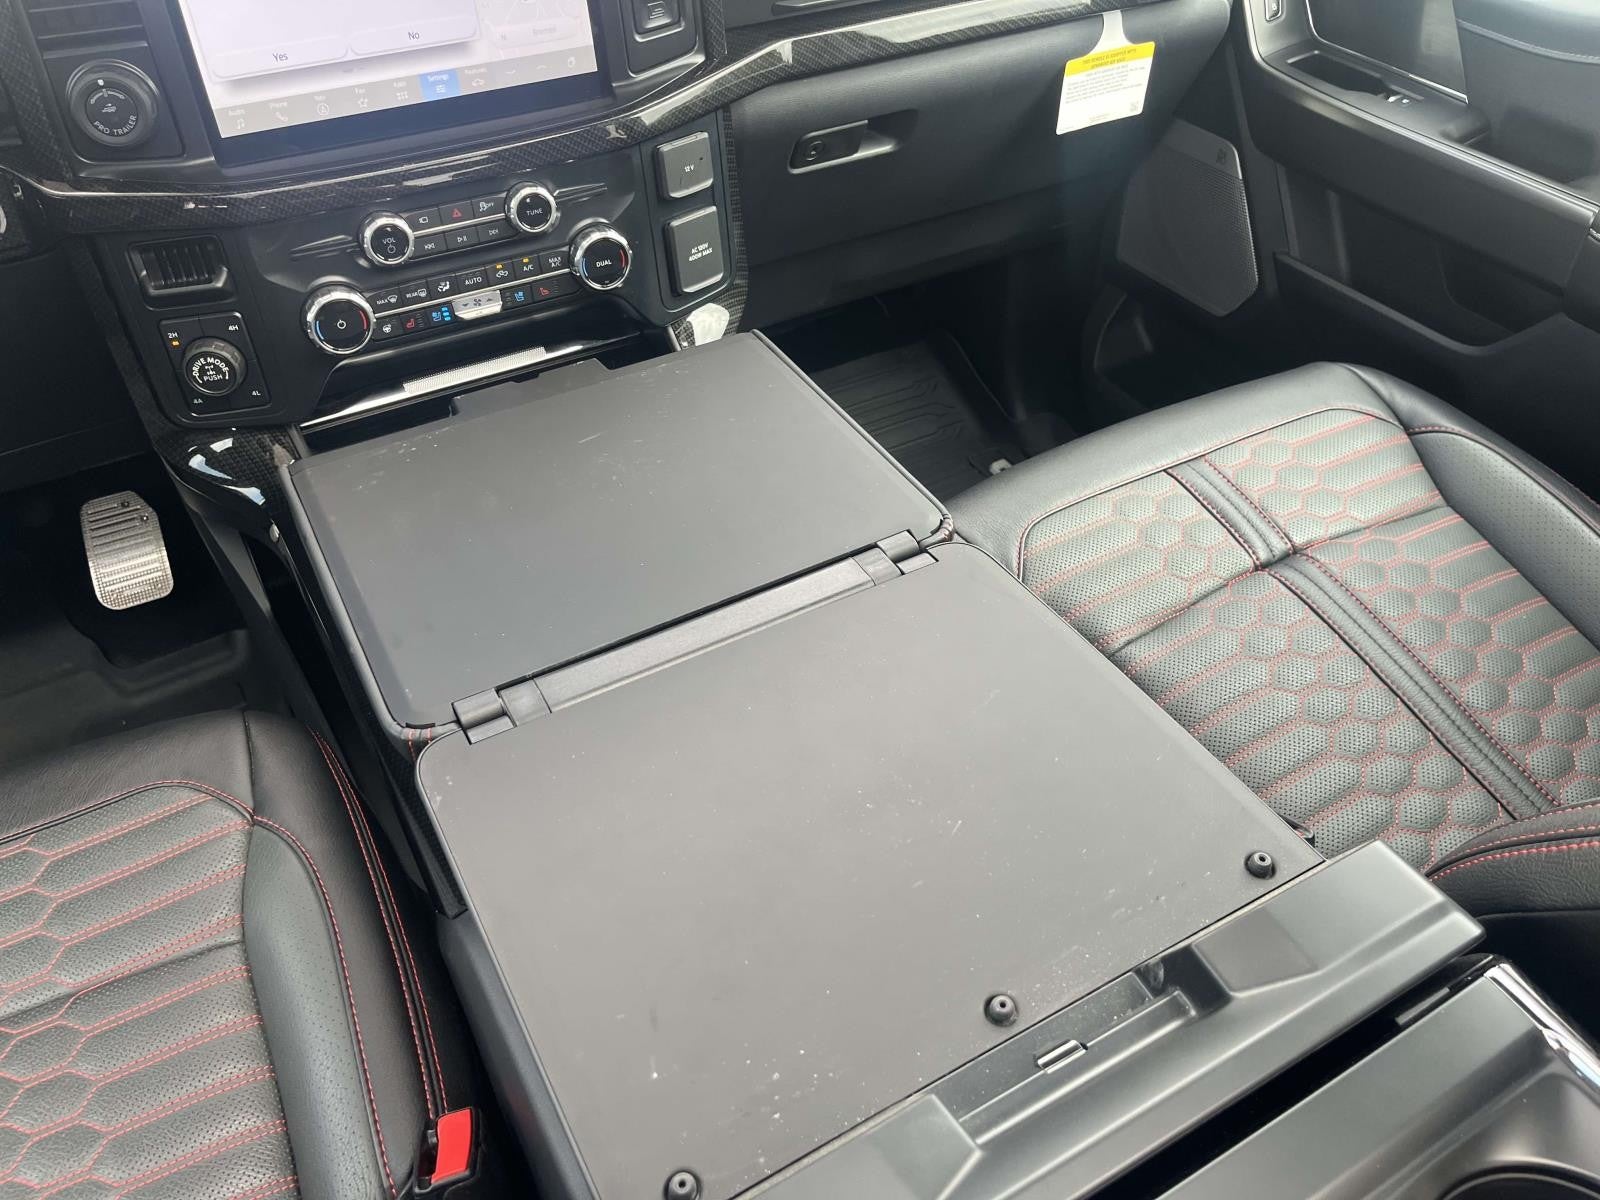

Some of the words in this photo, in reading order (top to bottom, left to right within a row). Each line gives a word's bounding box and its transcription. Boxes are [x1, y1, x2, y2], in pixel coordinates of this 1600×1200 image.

[407, 31, 420, 40] No
[272, 52, 289, 62] Yes
[94, 120, 110, 134] PRO
[113, 114, 137, 136] TRAILER
[684, 164, 691, 173] 12
[526, 207, 543, 216] TUNE
[382, 237, 396, 245] VOL
[691, 246, 699, 254] AC
[702, 247, 713, 256] MAX
[548, 256, 562, 264] MAX
[551, 260, 561, 268] A/C
[596, 259, 612, 268] DUAL
[523, 264, 534, 272] A/C
[465, 276, 482, 285] AUTO
[192, 357, 207, 377] DRIVE
[207, 356, 230, 373] MODE
[203, 374, 223, 382] PUSH
